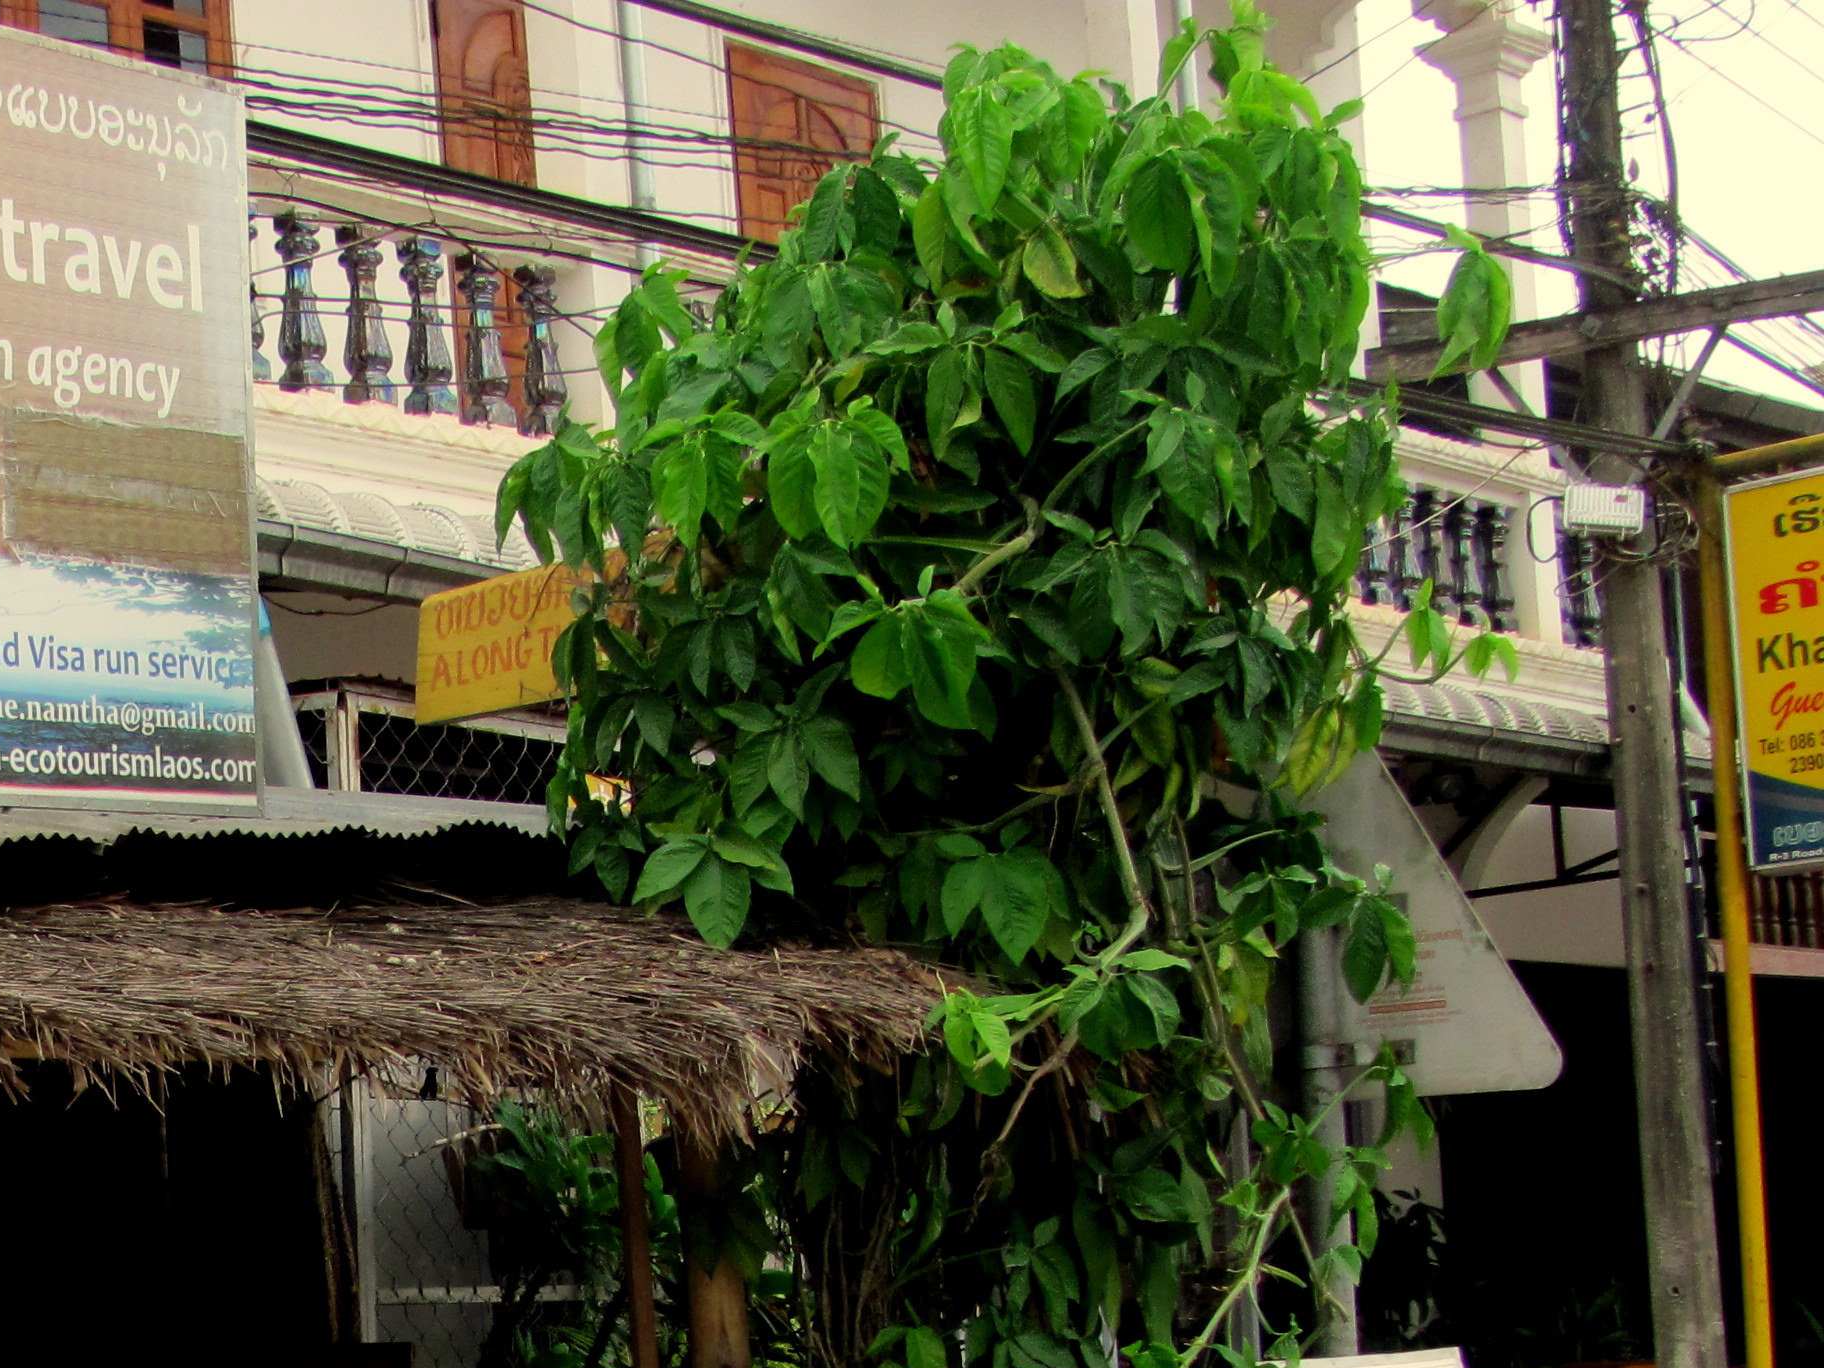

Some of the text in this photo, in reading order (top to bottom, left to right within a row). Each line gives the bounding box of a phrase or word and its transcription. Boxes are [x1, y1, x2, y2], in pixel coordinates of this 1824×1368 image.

[28, 345, 180, 419] agency
[28, 634, 85, 672] Visa
[94, 648, 140, 676] run
[430, 633, 533, 692] ALONG
